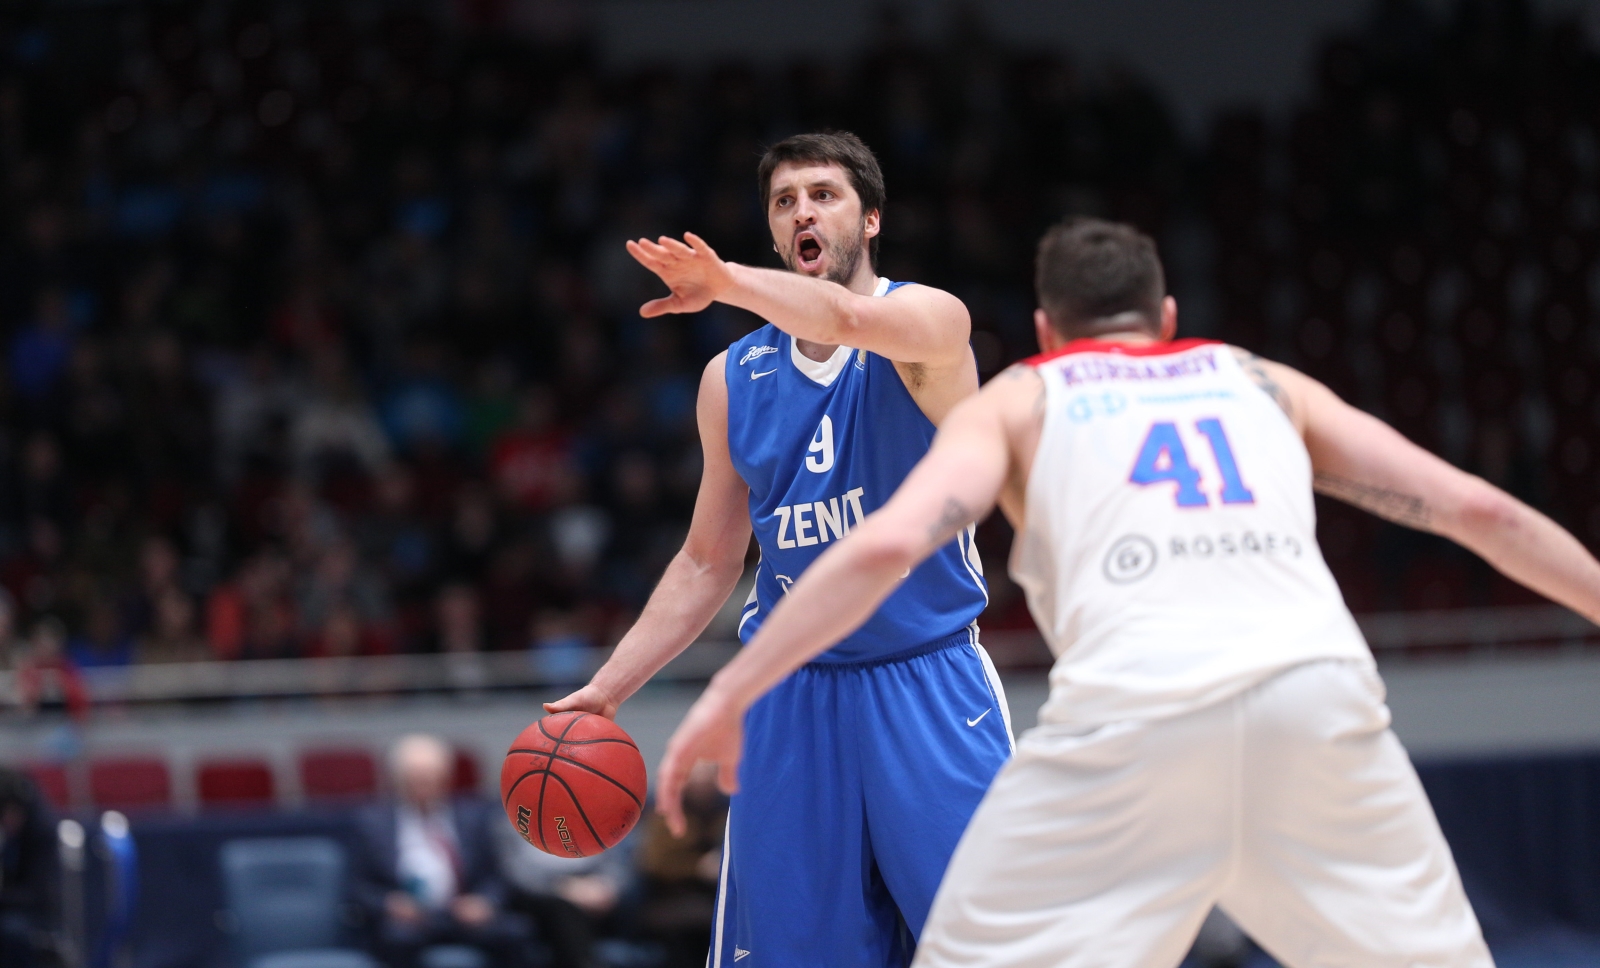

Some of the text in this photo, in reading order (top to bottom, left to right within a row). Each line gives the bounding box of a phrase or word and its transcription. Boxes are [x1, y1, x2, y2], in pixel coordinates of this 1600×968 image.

[805, 414, 834, 474] 9
[1127, 417, 1257, 508] 41
[773, 486, 866, 550] ZENIT
